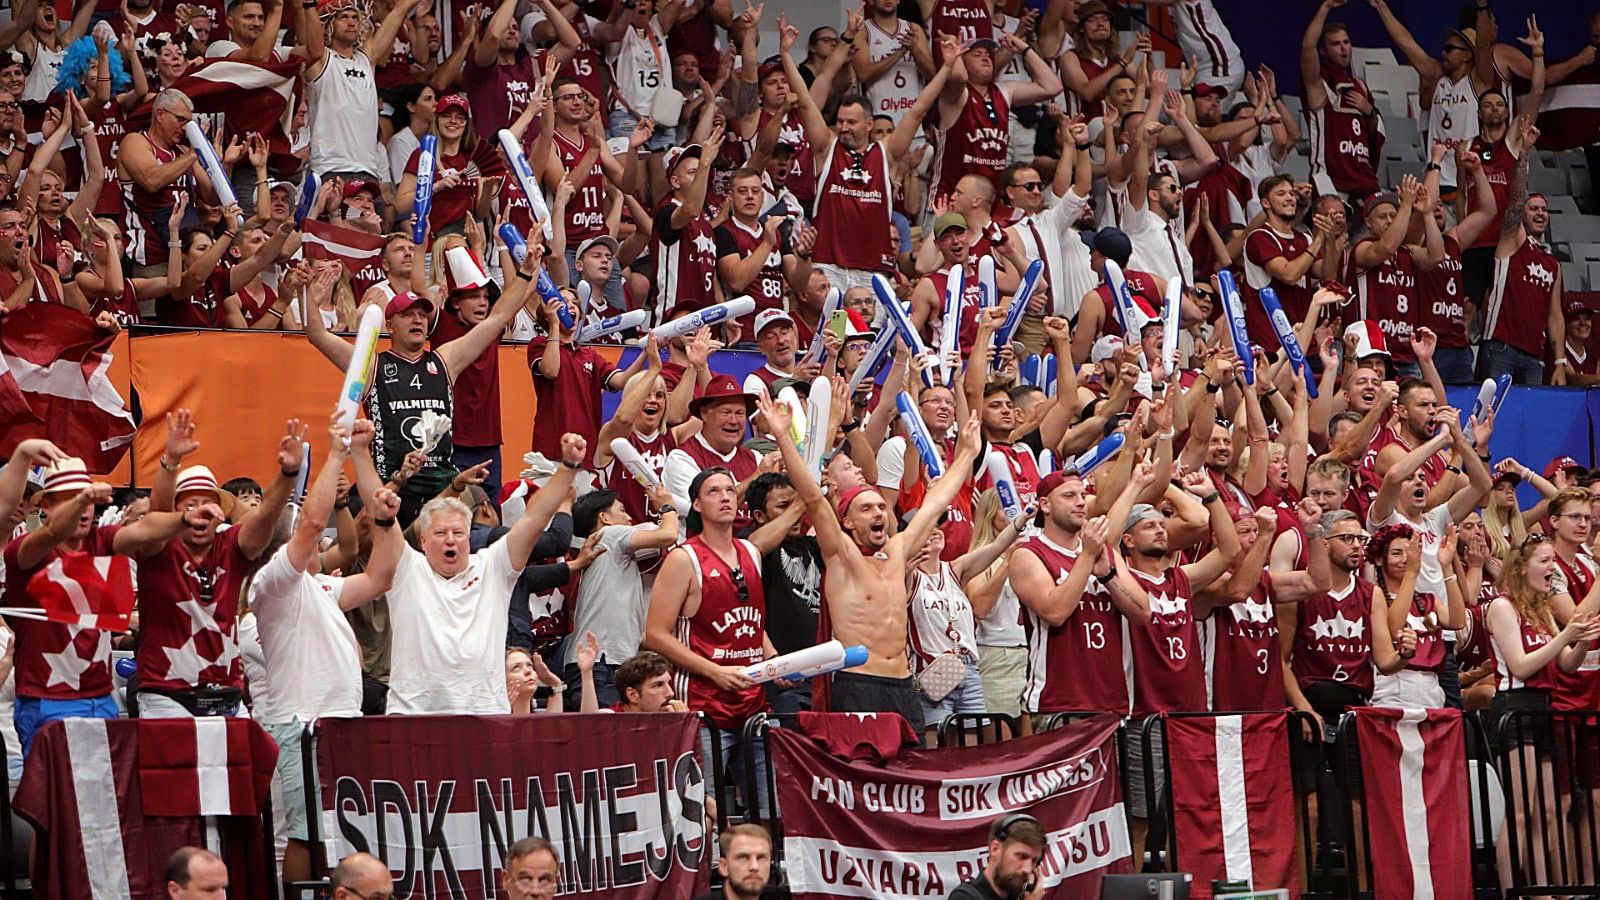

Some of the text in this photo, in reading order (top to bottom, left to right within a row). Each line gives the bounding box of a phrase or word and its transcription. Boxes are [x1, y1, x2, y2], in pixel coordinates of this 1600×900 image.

[572, 58, 592, 76] 15
[1004, 58, 1019, 74] 21
[638, 70, 660, 88] 15
[893, 71, 905, 88] 6
[1441, 111, 1453, 129] 6
[1339, 141, 1369, 157] OlyBe
[790, 159, 802, 176] 4
[582, 186, 598, 208] 11
[573, 212, 603, 228] OlyBet
[705, 272, 713, 292] 5
[761, 278, 778, 298] 88
[1446, 277, 1457, 296] 6
[1395, 294, 1408, 314] 8
[409, 373, 422, 391] 4
[388, 398, 445, 415] VALMIERA
[1082, 621, 1106, 650] 13
[1167, 636, 1187, 660] 13
[1308, 643, 1371, 654] LATVIJA
[1256, 648, 1269, 674] 3
[1332, 664, 1350, 682] 6
[862, 782, 925, 814] CLUB
[947, 782, 993, 814] SDK
[334, 750, 705, 900] SDK NAMEJS
